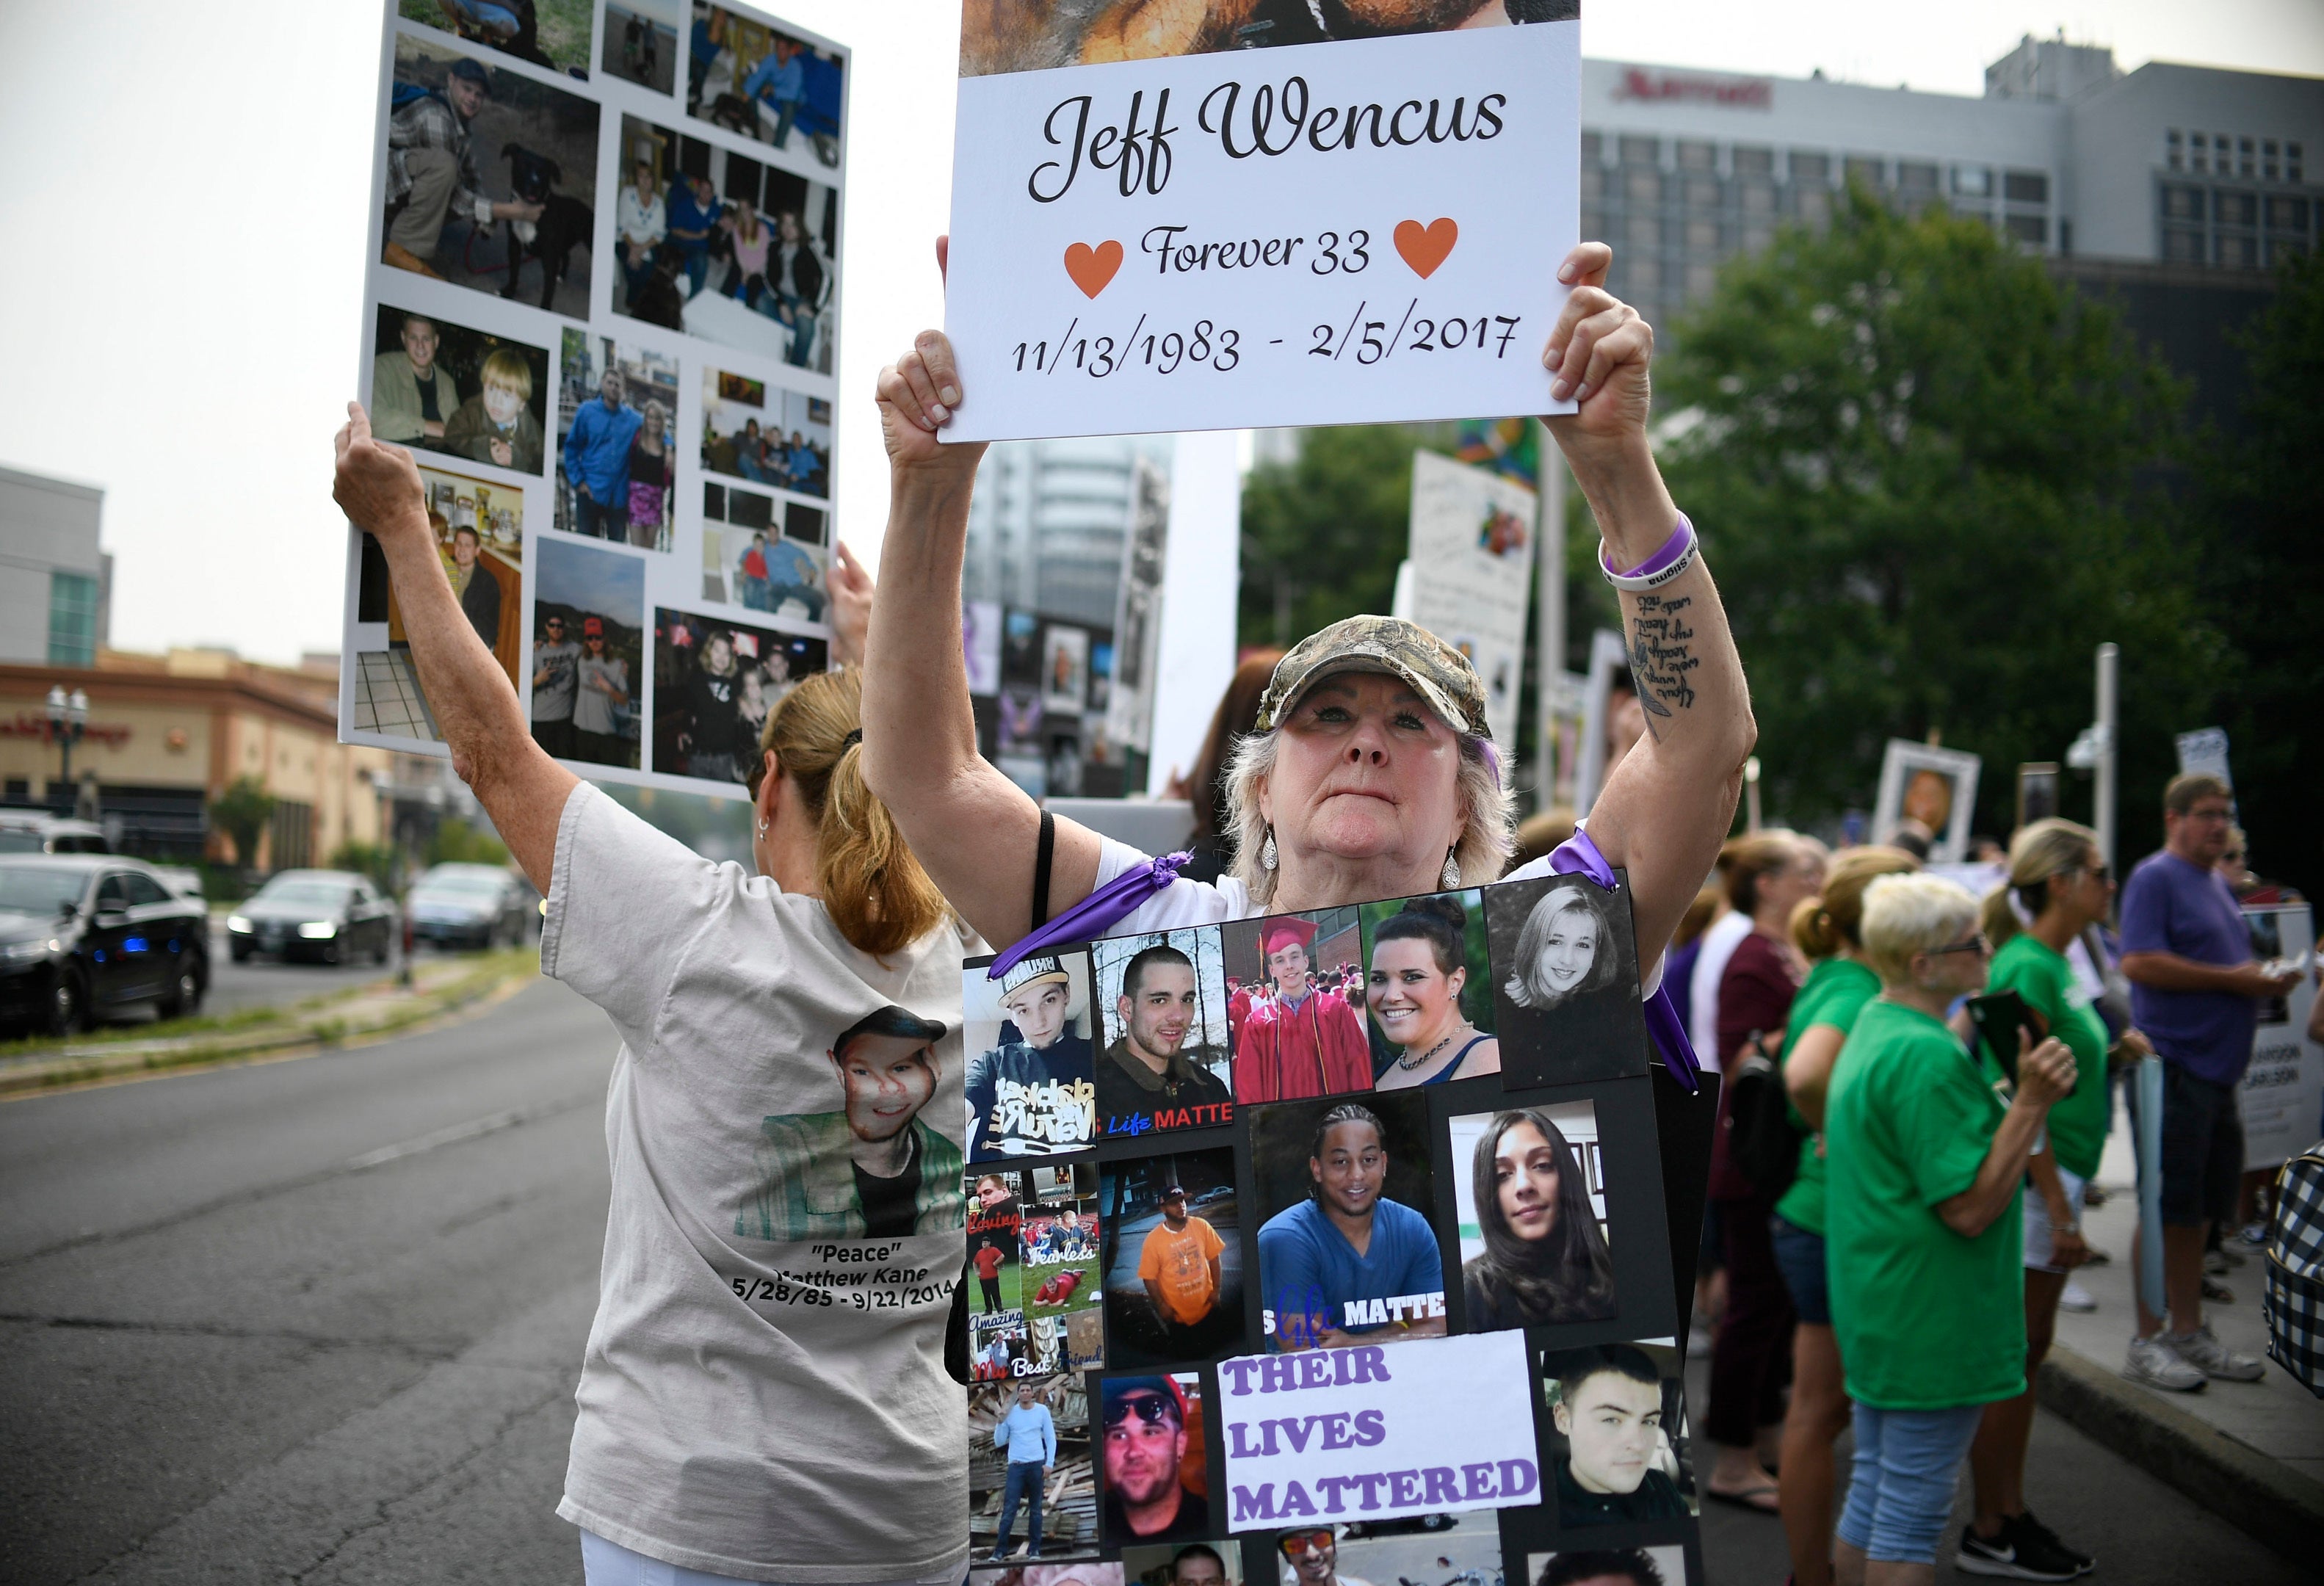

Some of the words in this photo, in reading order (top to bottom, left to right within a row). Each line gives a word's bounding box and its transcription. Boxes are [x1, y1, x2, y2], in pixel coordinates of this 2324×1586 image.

[1028, 88, 1179, 203] Jeff
[1198, 76, 1507, 159] Wencus
[1141, 225, 1303, 274] Forever
[1311, 229, 1371, 275] 33
[1011, 314, 1241, 378] 11/13/1983
[1308, 298, 1521, 365] 2/5/2017
[1648, 558, 1687, 585] Stigma
[967, 1212, 1020, 1236] Loving
[811, 1242, 902, 1264] "Peace"
[1027, 1242, 1096, 1267] Fearless
[872, 1267, 928, 1285] Kane
[733, 1278, 833, 1307] 5/28/85
[852, 1280, 955, 1310] 9/22/2014
[969, 1311, 1024, 1332] Amazing
[1011, 1354, 1052, 1377] Best
[1223, 1346, 1391, 1396] THEIR
[1228, 1410, 1386, 1459] LIVES
[1232, 1458, 1538, 1522] MATTERED
